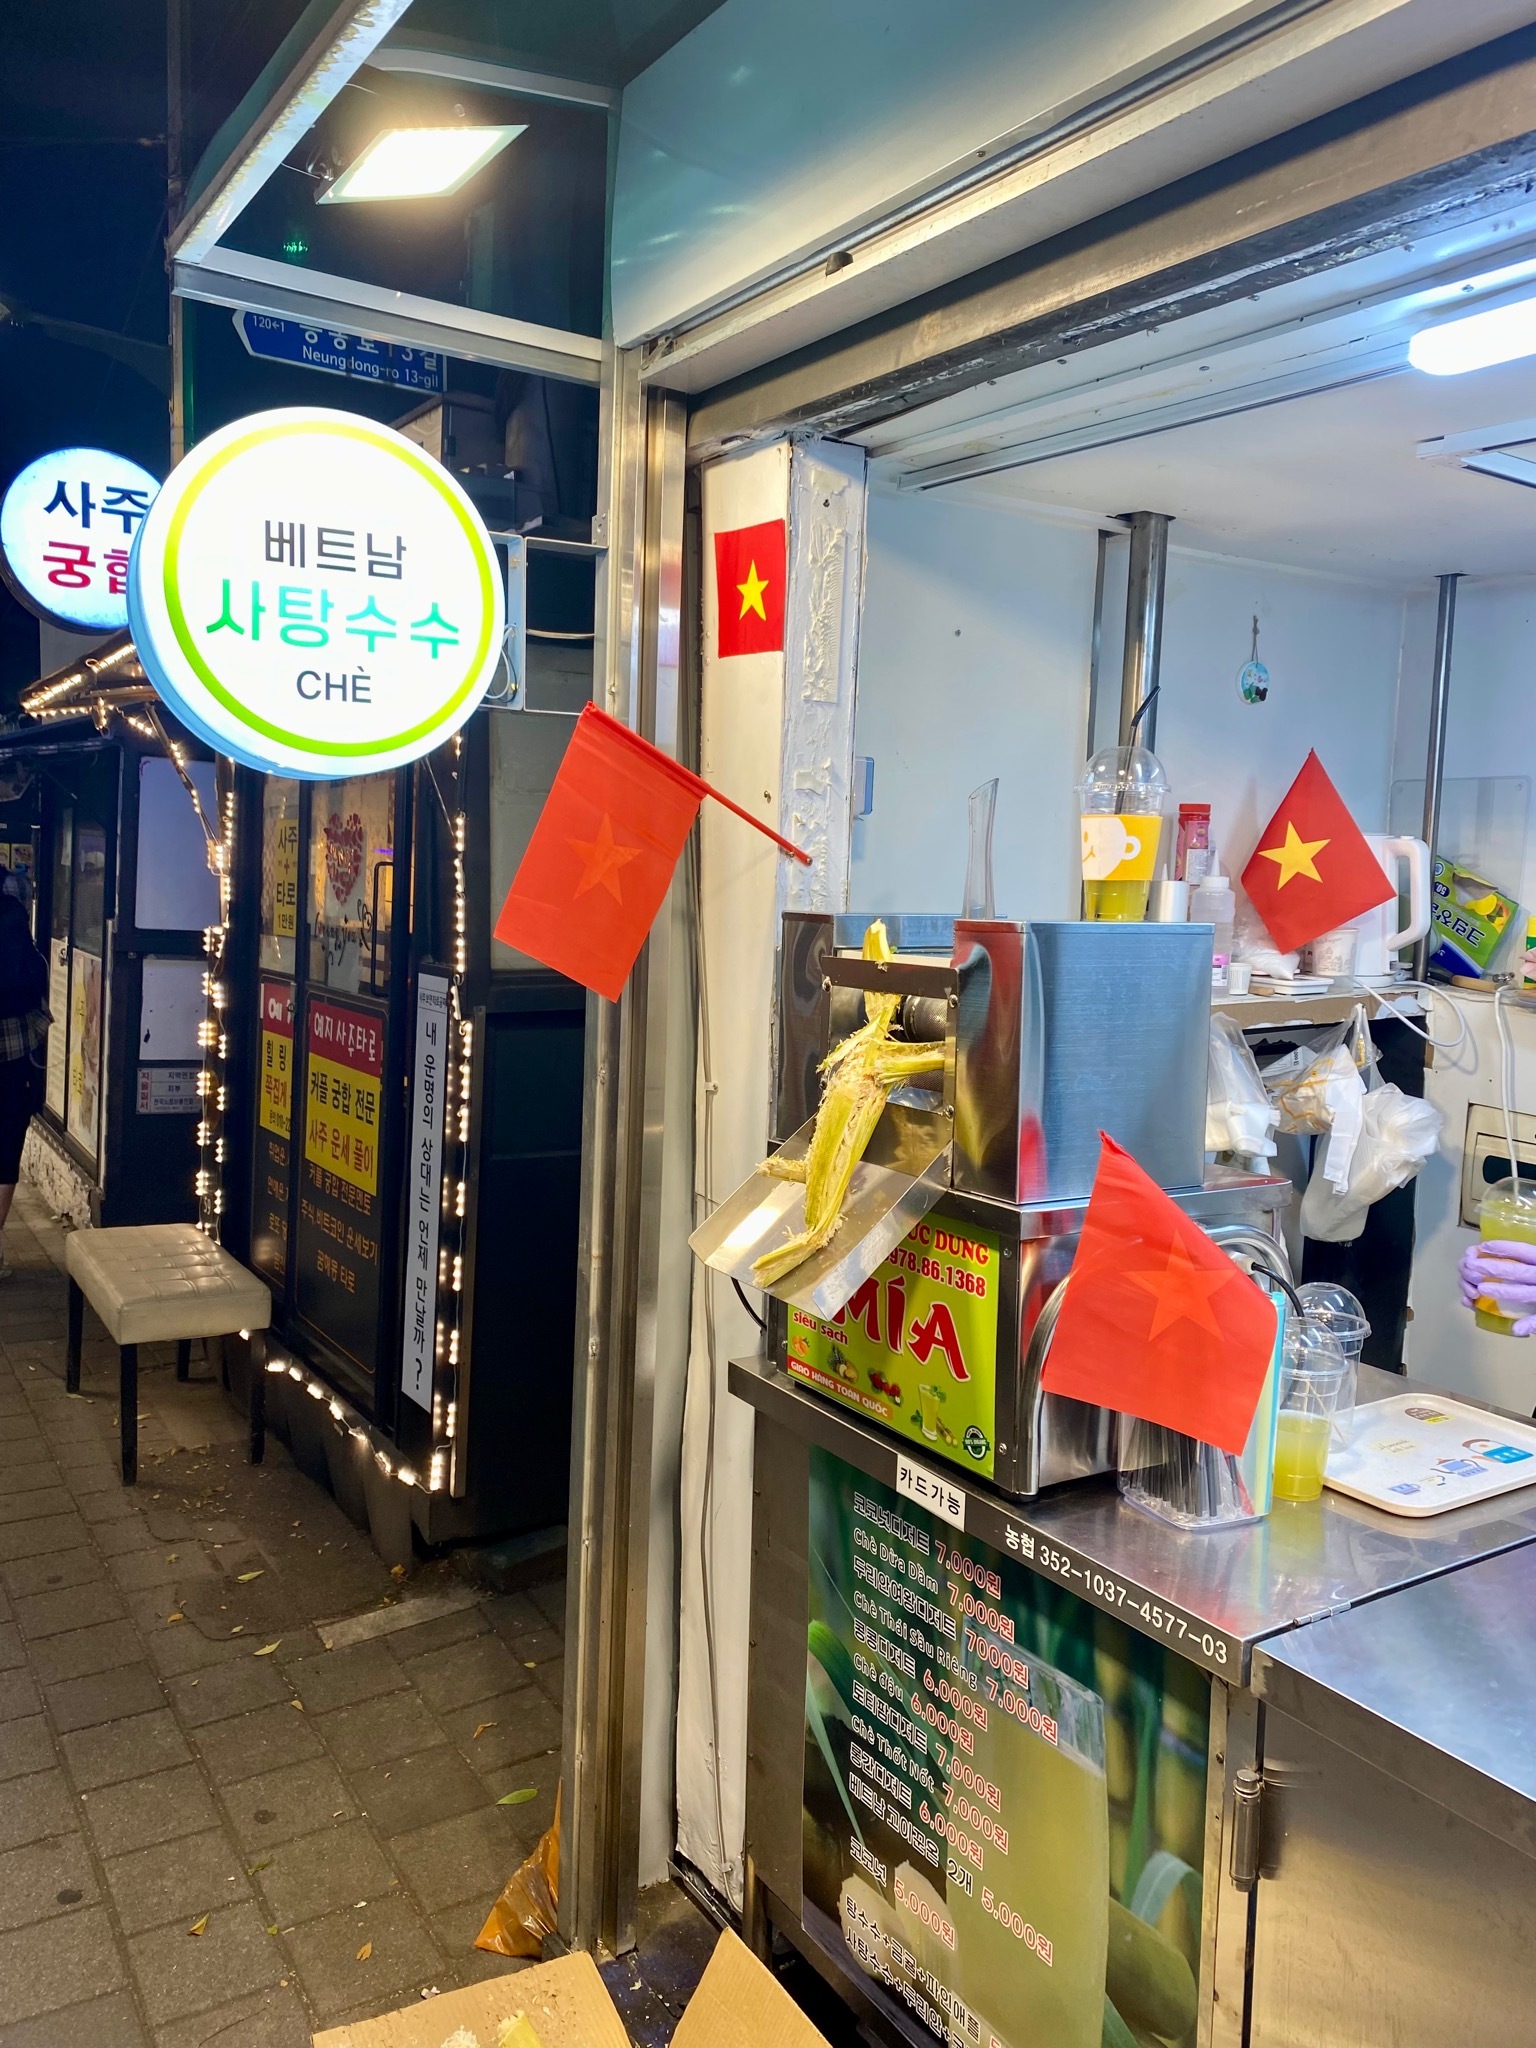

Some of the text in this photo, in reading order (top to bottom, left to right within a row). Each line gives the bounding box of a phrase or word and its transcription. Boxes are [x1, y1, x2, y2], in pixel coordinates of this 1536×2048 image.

[303, 345, 438, 388] Neungdong-ro 13-gil
[43, 478, 152, 534] 사주
[264, 519, 407, 580] 베트남
[205, 578, 460, 660] 사탕수수
[296, 665, 372, 704] CHÈ
[278, 826, 297, 854] 사주
[276, 880, 296, 907] 타로
[425, 1021, 437, 1047] 내
[310, 1071, 376, 1126] 커플 궁합 전문
[422, 1054, 436, 1130] 운명의
[309, 1118, 374, 1179] 사주 운세 풀이
[419, 1137, 433, 1213] 상대는
[417, 1220, 429, 1271] 언제
[885, 1247, 986, 1298] 978.86.1368
[934, 1228, 989, 1265] DUNG
[793, 1310, 848, 1346] siêu sạch
[831, 1275, 971, 1382] MÍA
[790, 1360, 810, 1378] GIAO
[811, 1368, 834, 1390] HÀNG
[853, 1491, 1002, 1600] 코코넛디저트 7.000원
[853, 1527, 878, 1556] Chè
[947, 1581, 1015, 1645] 7.000원
[1005, 1523, 1228, 1665] 농협 352-1037-4577-03
[853, 1590, 878, 1618] Chè
[878, 1605, 907, 1640] Thái
[936, 1646, 978, 1692] Riêng
[985, 1676, 1058, 1746] 7.000원
[853, 1617, 988, 1732] 콩콩디저트 6.000원
[965, 1629, 1029, 1691] 7000원
[853, 1653, 877, 1682] Chè
[911, 1692, 974, 1757] 6.000원
[851, 1714, 875, 1745] Chè
[942, 1782, 1009, 1856] 7.000원
[935, 1742, 1001, 1813] 7.000원
[918, 1800, 983, 1871] 6.000원
[849, 1771, 886, 1821] 베트남
[947, 1857, 974, 1897] 2개
[981, 1886, 1053, 1967] 5.000원
[850, 1835, 955, 1951] 코코넛 5.000원
